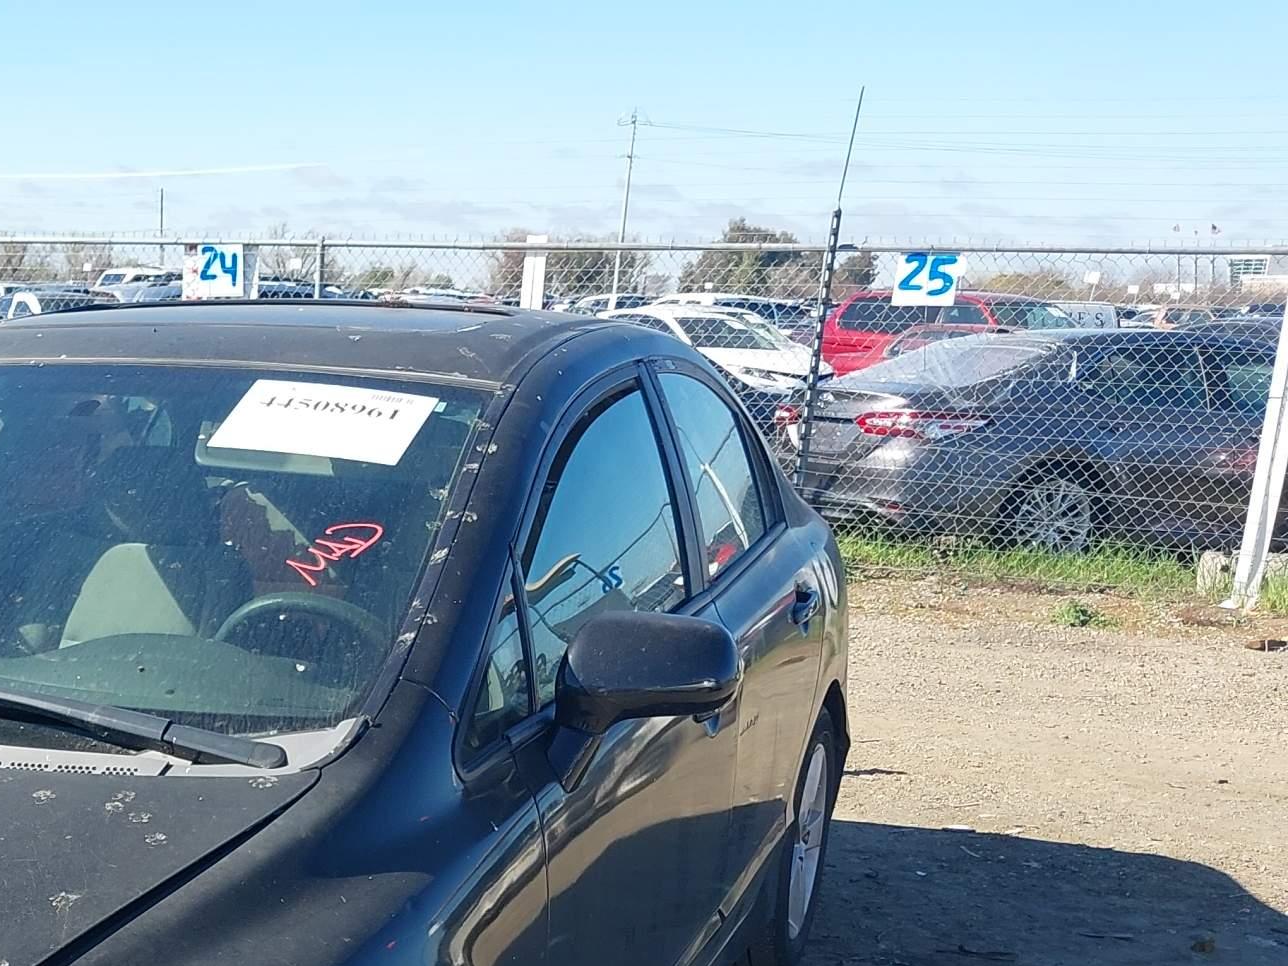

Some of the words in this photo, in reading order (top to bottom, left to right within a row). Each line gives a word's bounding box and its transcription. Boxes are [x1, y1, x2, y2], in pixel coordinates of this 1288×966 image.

[200, 246, 237, 287] 24
[898, 252, 958, 296] 25
[260, 396, 400, 420] 44508961
